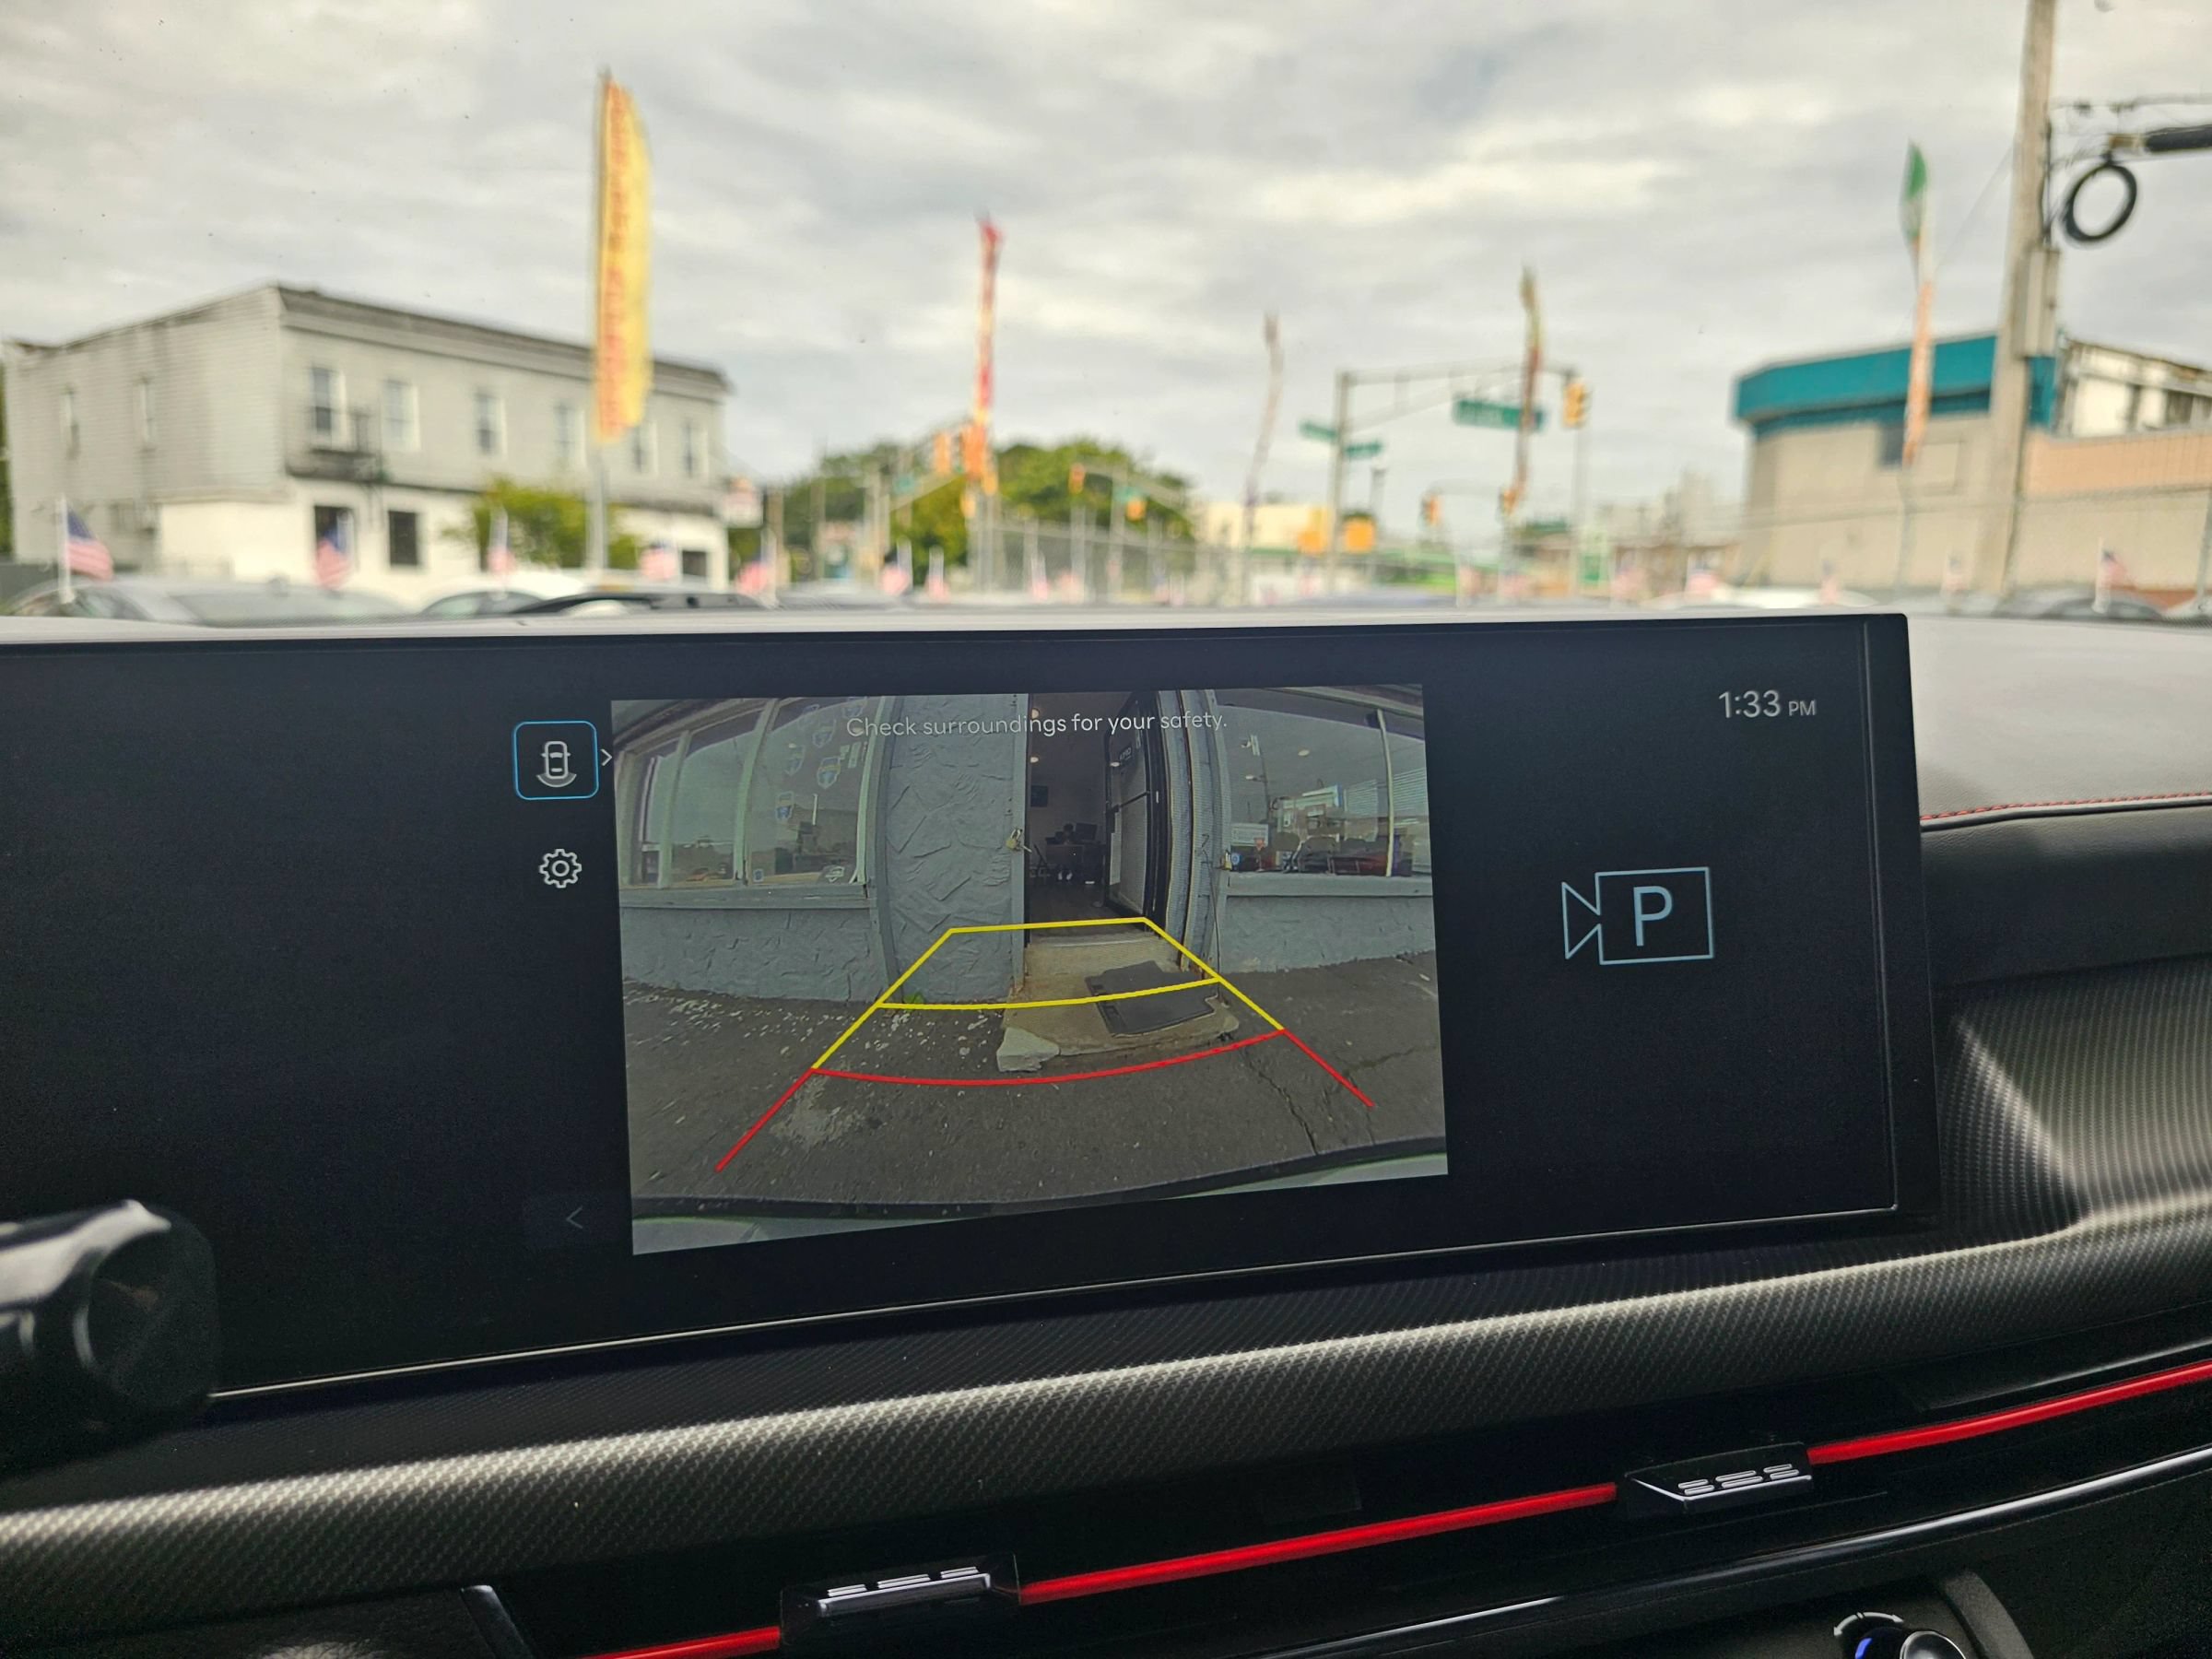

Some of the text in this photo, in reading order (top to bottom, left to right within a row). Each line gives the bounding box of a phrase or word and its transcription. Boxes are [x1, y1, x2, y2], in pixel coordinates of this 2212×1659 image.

[1718, 689, 1817, 718] 1:33 PM
[846, 710, 1228, 737] Check surroundings for your safety.
[1633, 885, 1673, 947] P
